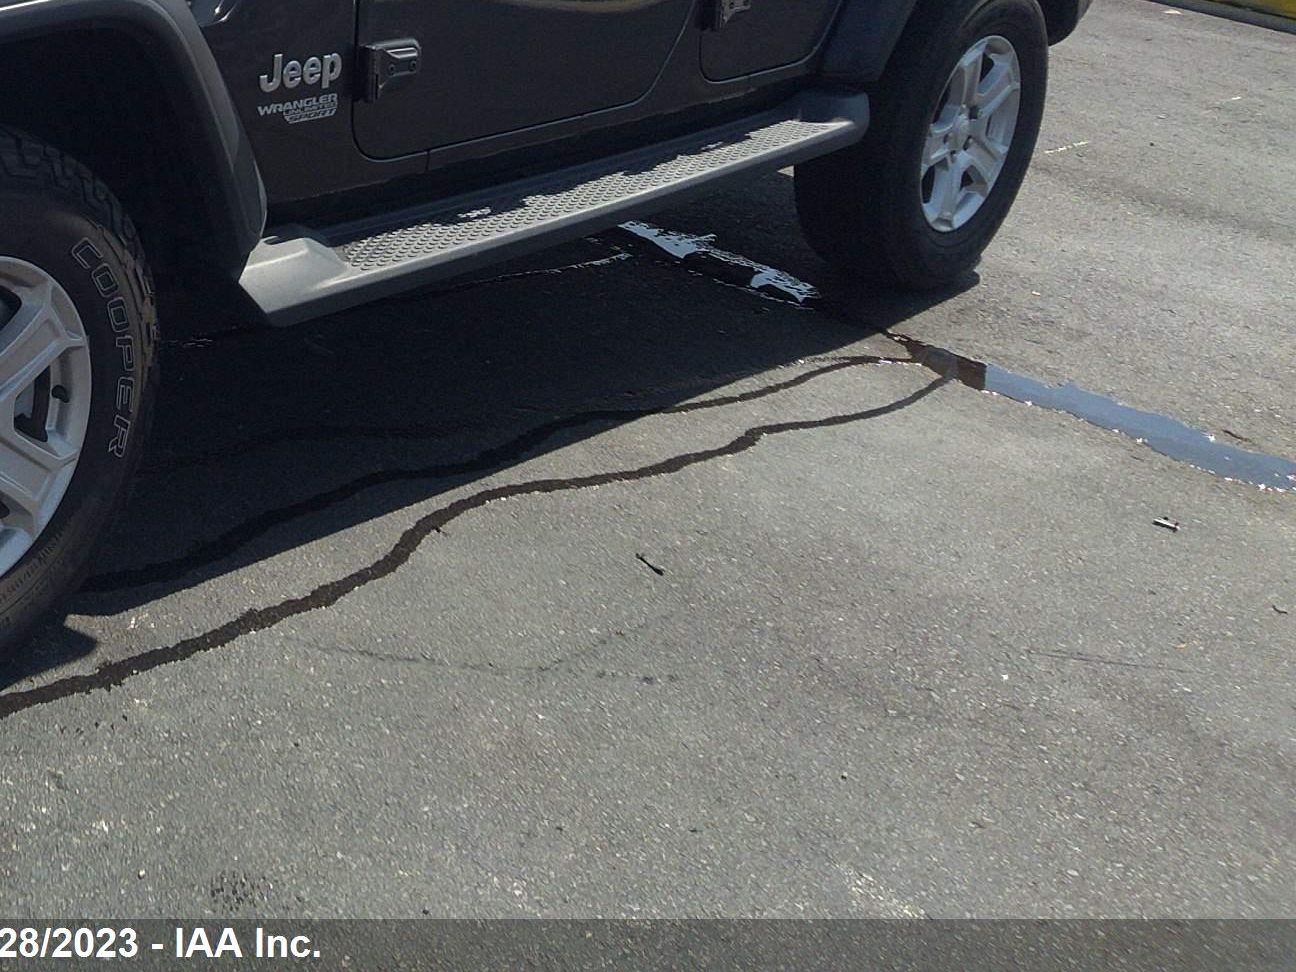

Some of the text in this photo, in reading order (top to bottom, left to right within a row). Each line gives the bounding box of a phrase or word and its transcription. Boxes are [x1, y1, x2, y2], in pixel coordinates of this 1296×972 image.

[259, 52, 343, 93] Jeep
[257, 93, 338, 117] WRANGLER
[71, 236, 135, 459] COOPER
